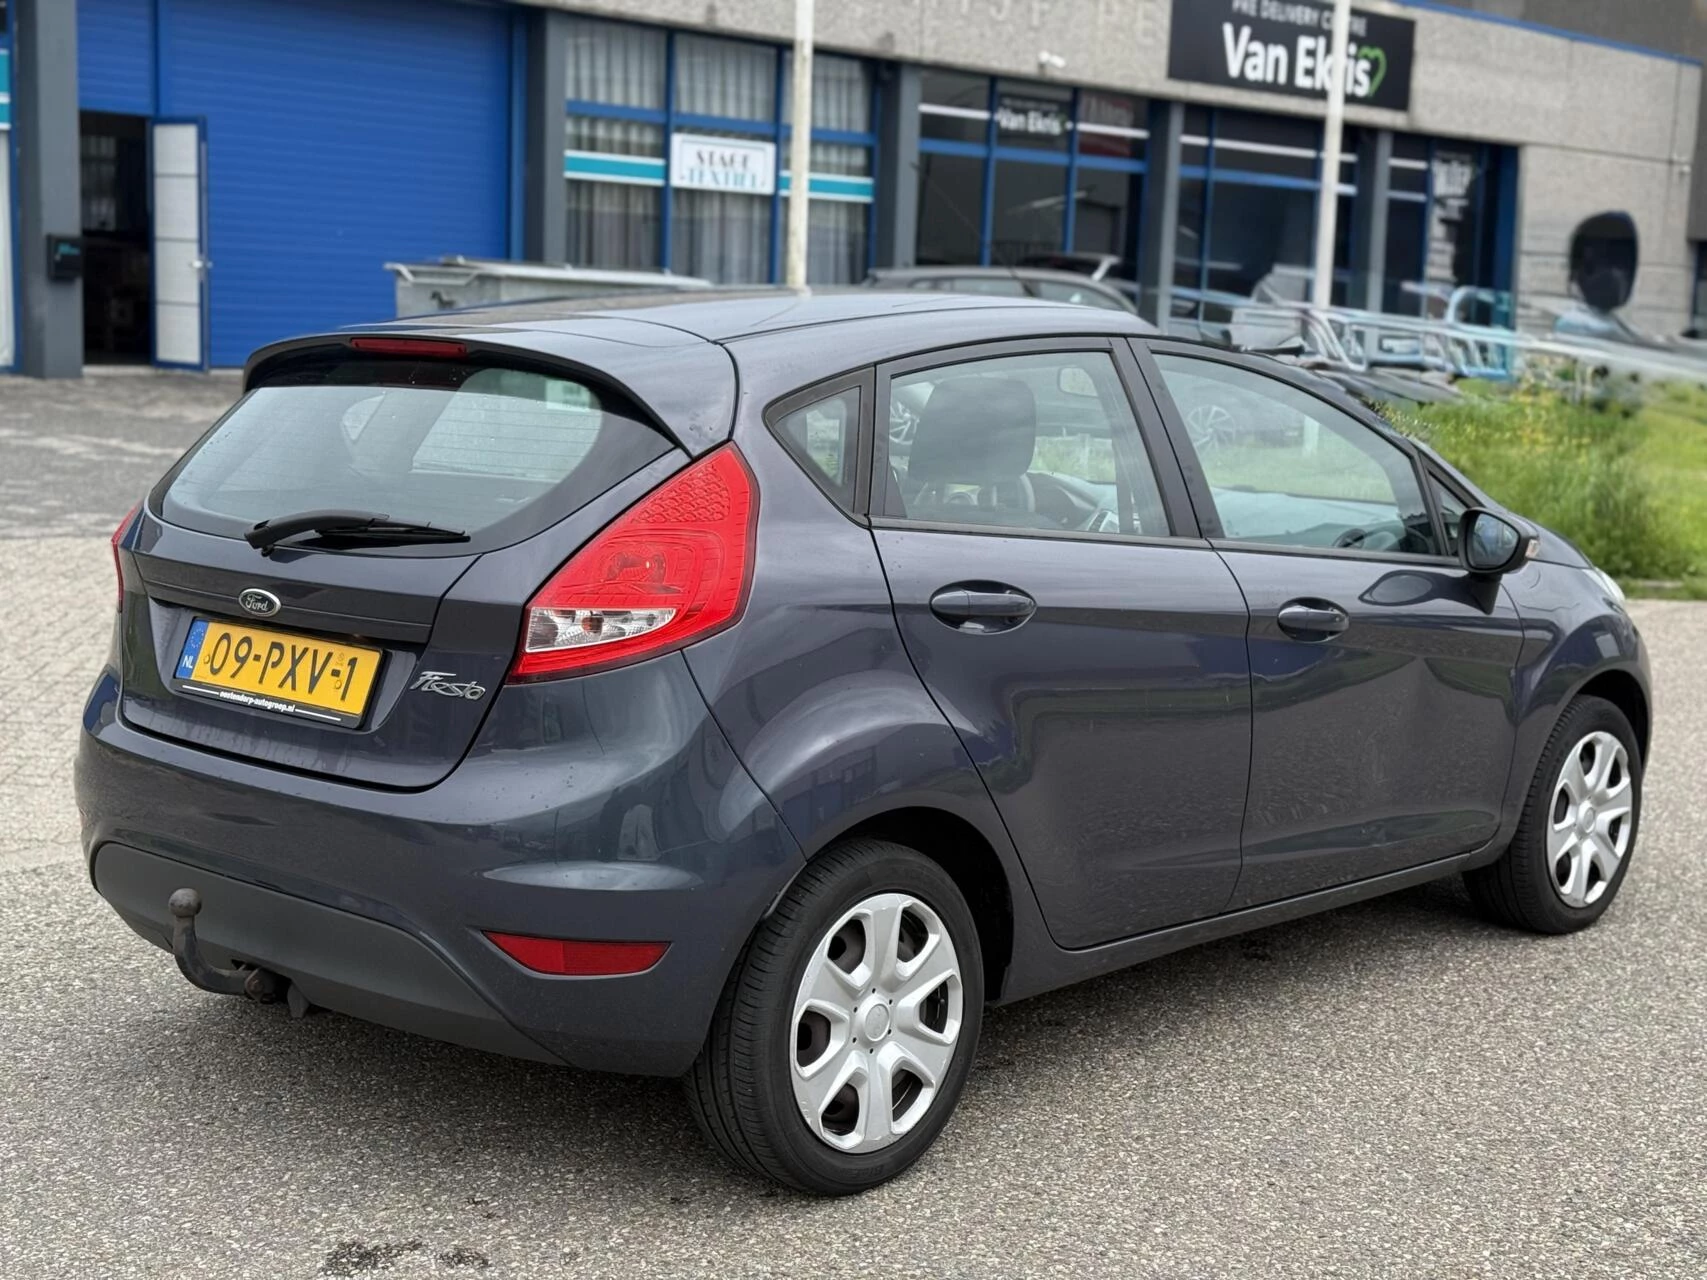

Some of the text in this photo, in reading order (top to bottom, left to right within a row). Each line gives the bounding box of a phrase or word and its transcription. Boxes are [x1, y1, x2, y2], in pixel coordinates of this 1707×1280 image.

[1232, 0, 1257, 17] PRE
[1260, 0, 1320, 28] DELIVERY
[1222, 21, 1289, 86] Van
[1294, 34, 1372, 99] Ekis
[245, 593, 269, 612] Ford
[182, 654, 194, 670] NL
[209, 632, 358, 701] 09-PXV-1
[409, 670, 486, 701] Fiesta
